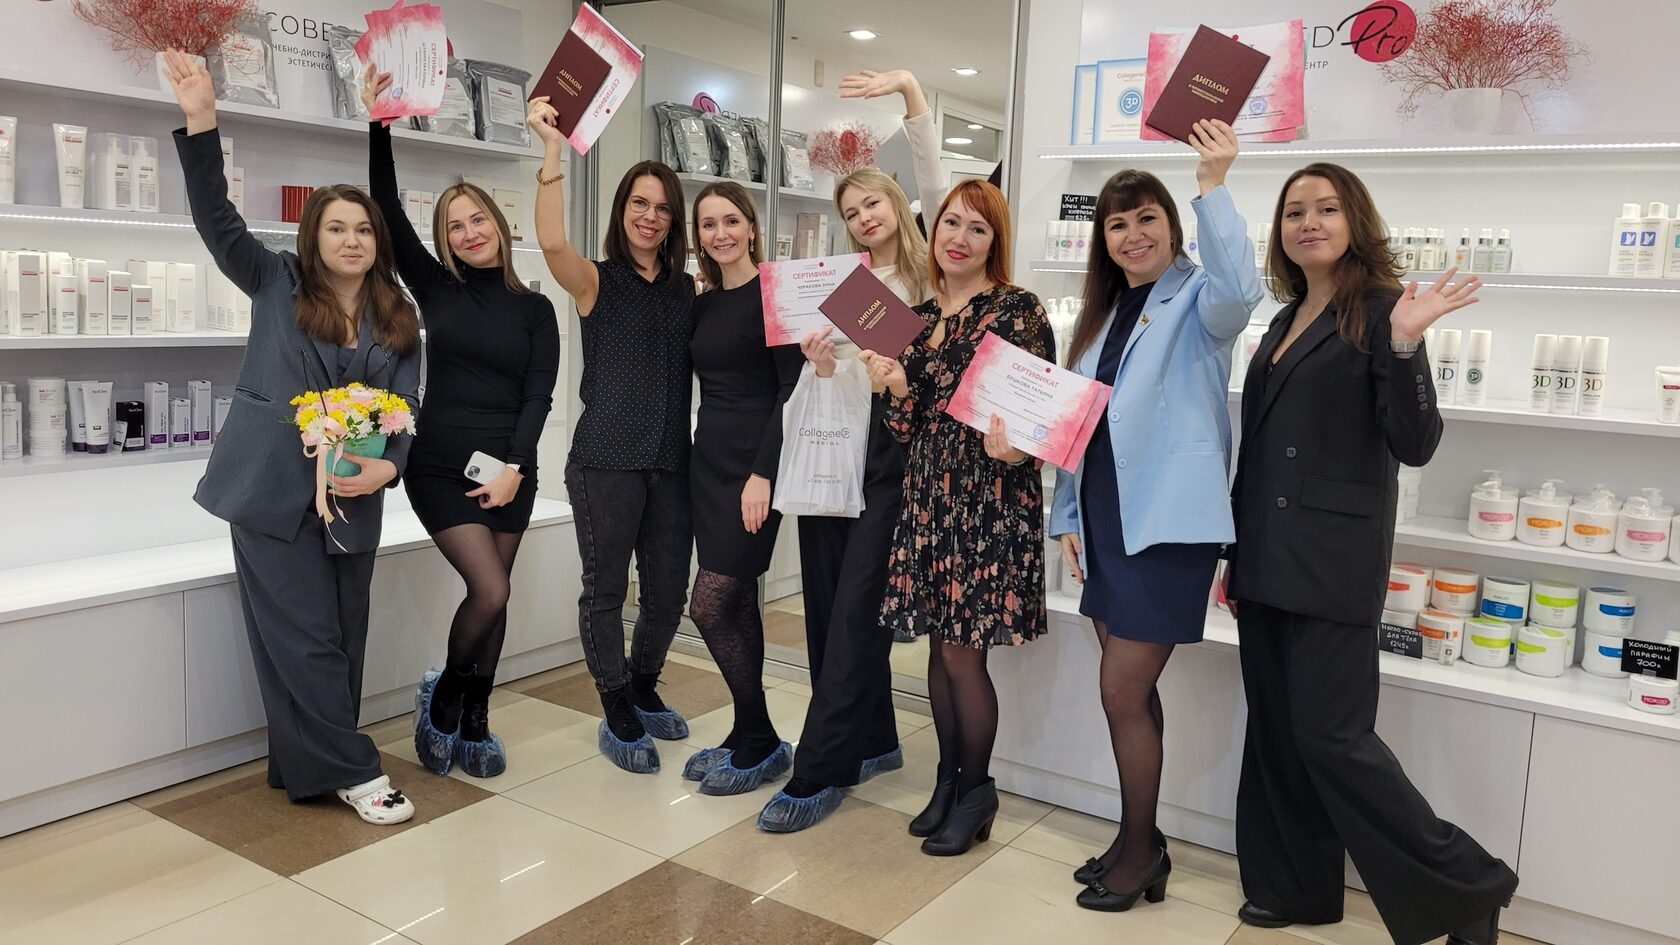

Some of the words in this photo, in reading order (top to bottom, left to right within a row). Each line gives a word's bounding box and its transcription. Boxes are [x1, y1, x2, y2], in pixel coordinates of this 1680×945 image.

[1337, 5, 1408, 54] Pro
[559, 69, 583, 91] ДИПЛОМ
[1192, 73, 1230, 95] ДИПЛОМ
[593, 78, 620, 118] СЕРТИФИКАТ
[793, 270, 836, 279] СЕРТИФИКАТ
[857, 300, 882, 326] ДИПЛОМ
[1012, 363, 1060, 388] СЕРТИФИКАТ
[1531, 375, 1552, 389] 3D
[1555, 376, 1576, 390] 3D
[1583, 378, 1603, 392] 3D
